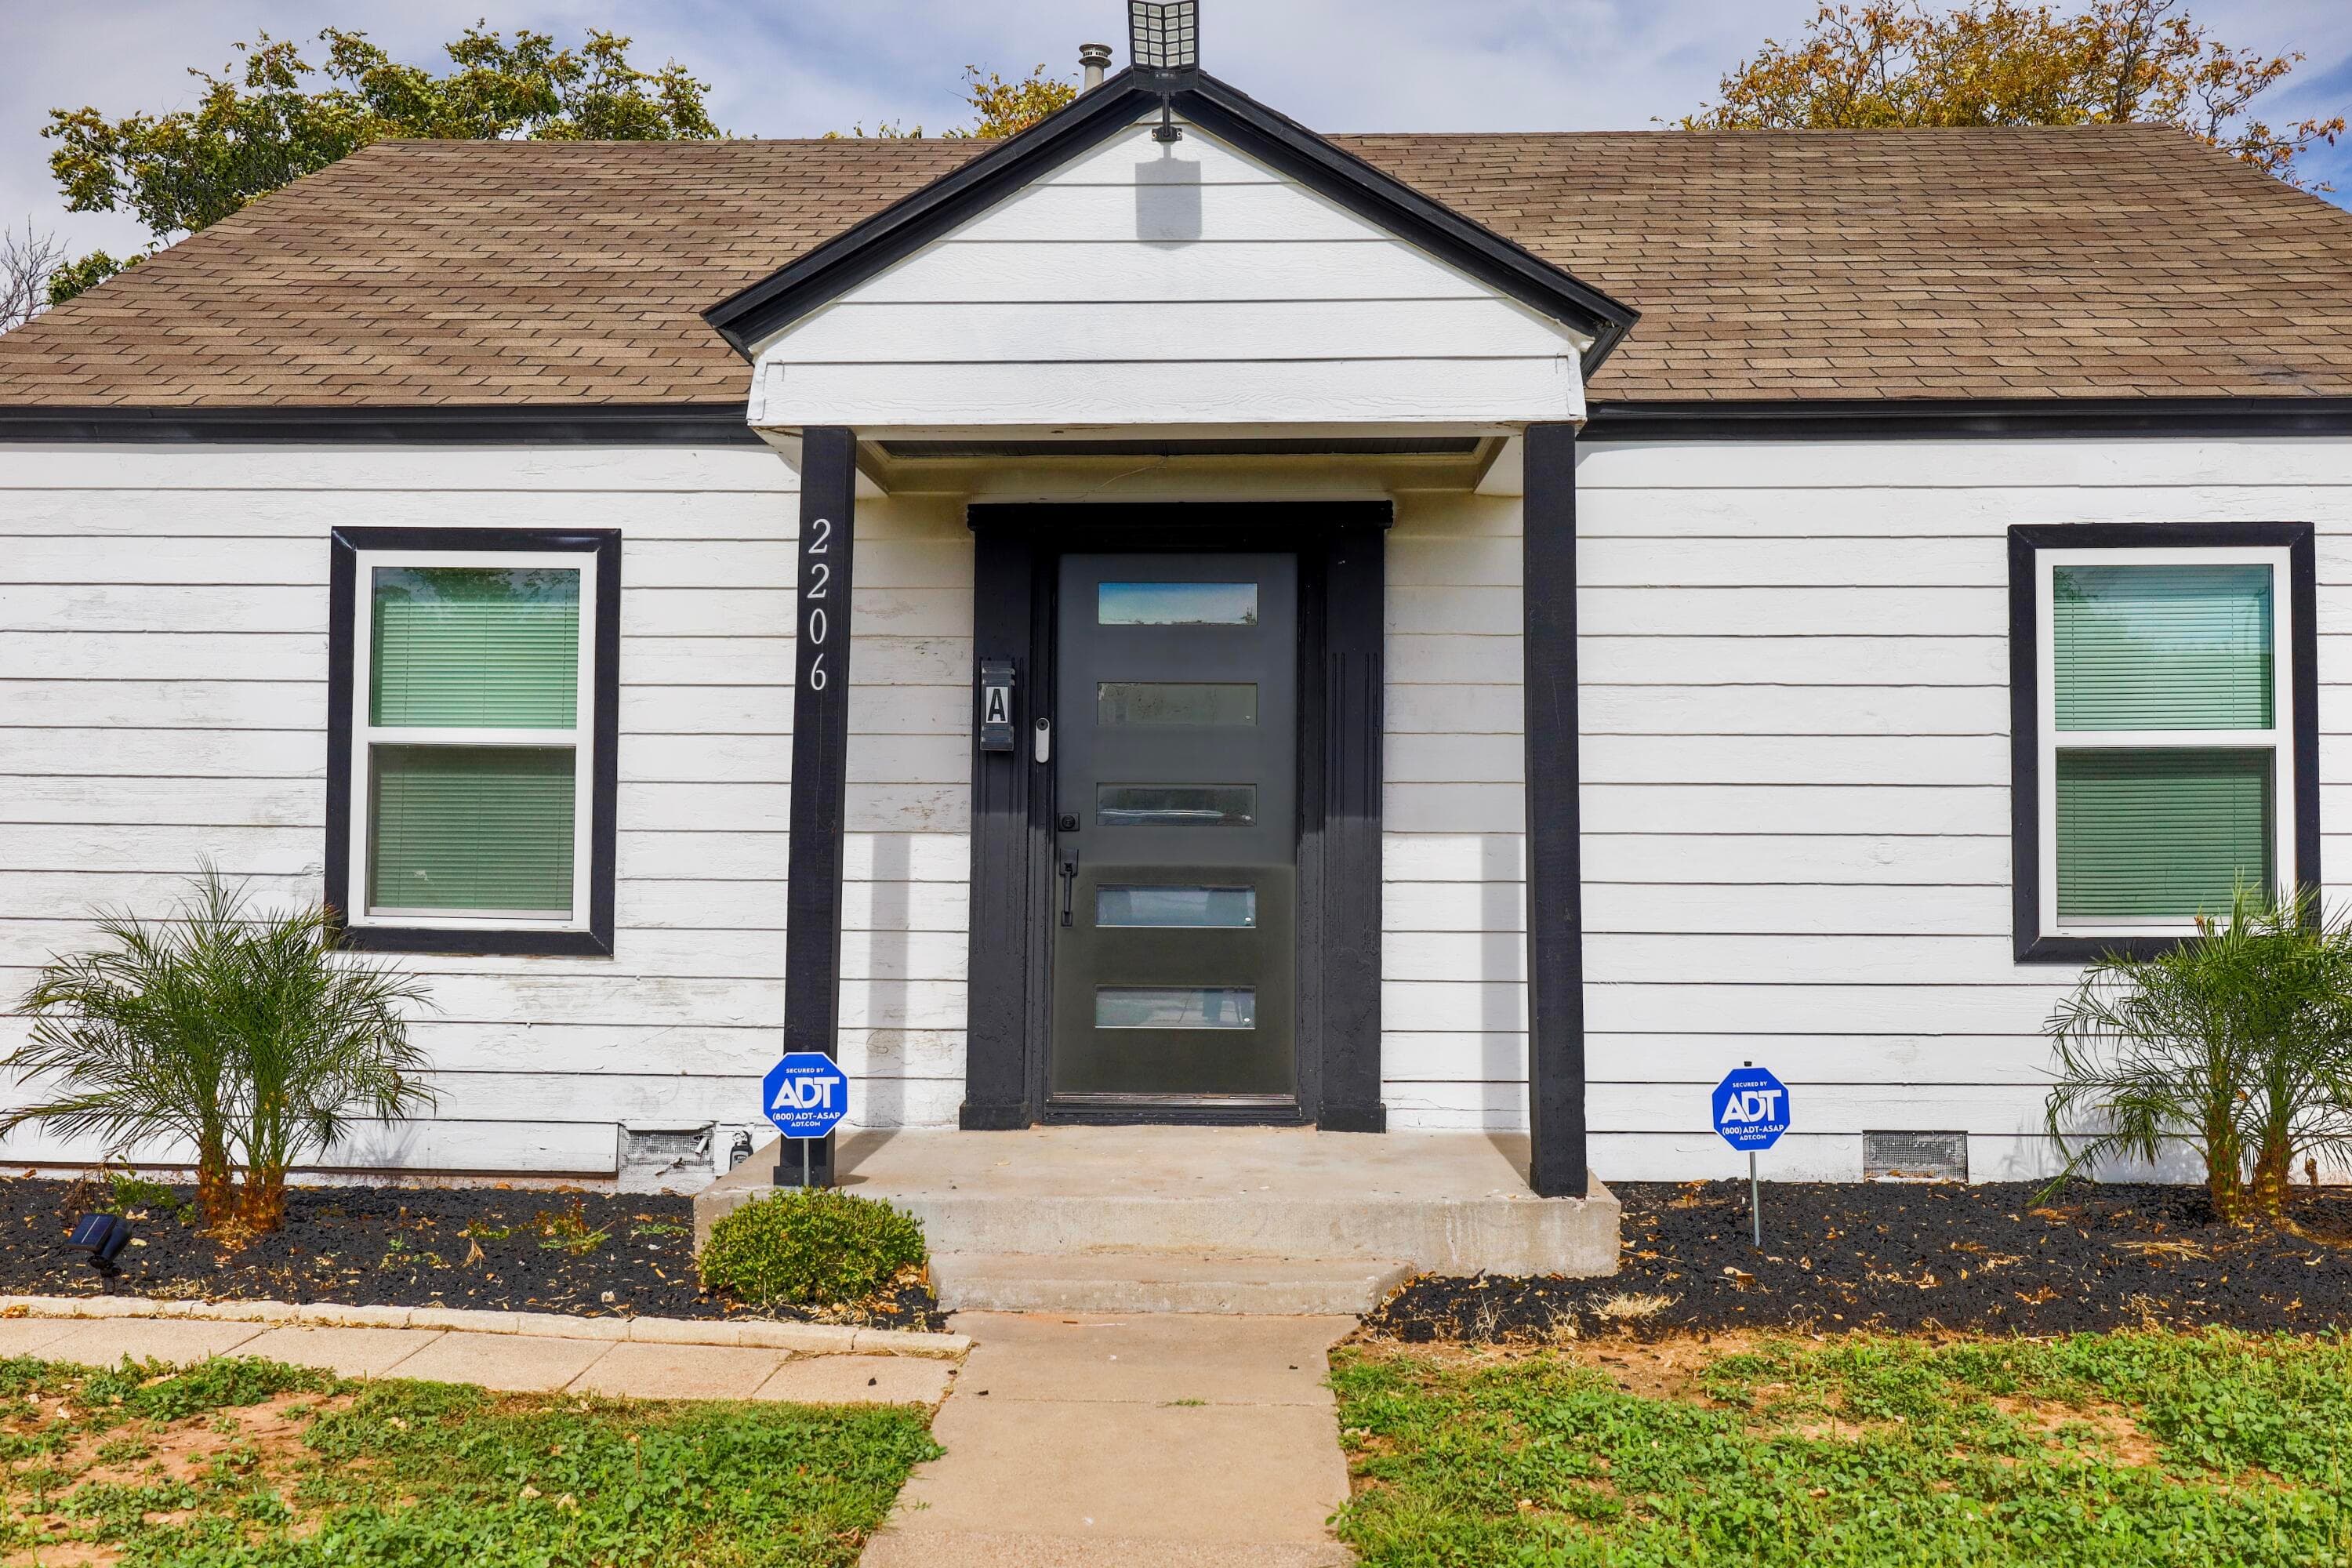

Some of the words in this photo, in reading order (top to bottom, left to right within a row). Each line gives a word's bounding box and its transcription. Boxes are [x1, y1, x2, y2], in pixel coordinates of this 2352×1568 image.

[808, 518, 831, 691] 2206
[987, 688, 1006, 722] A
[771, 1076, 840, 1109] ADT
[1719, 1089, 1782, 1124] ADT
[772, 1112, 794, 1121] (800)
[795, 1112, 840, 1120] ADT-ASAP
[1722, 1127, 1742, 1135] (800)
[1743, 1124, 1784, 1134] ADT-ASAP
